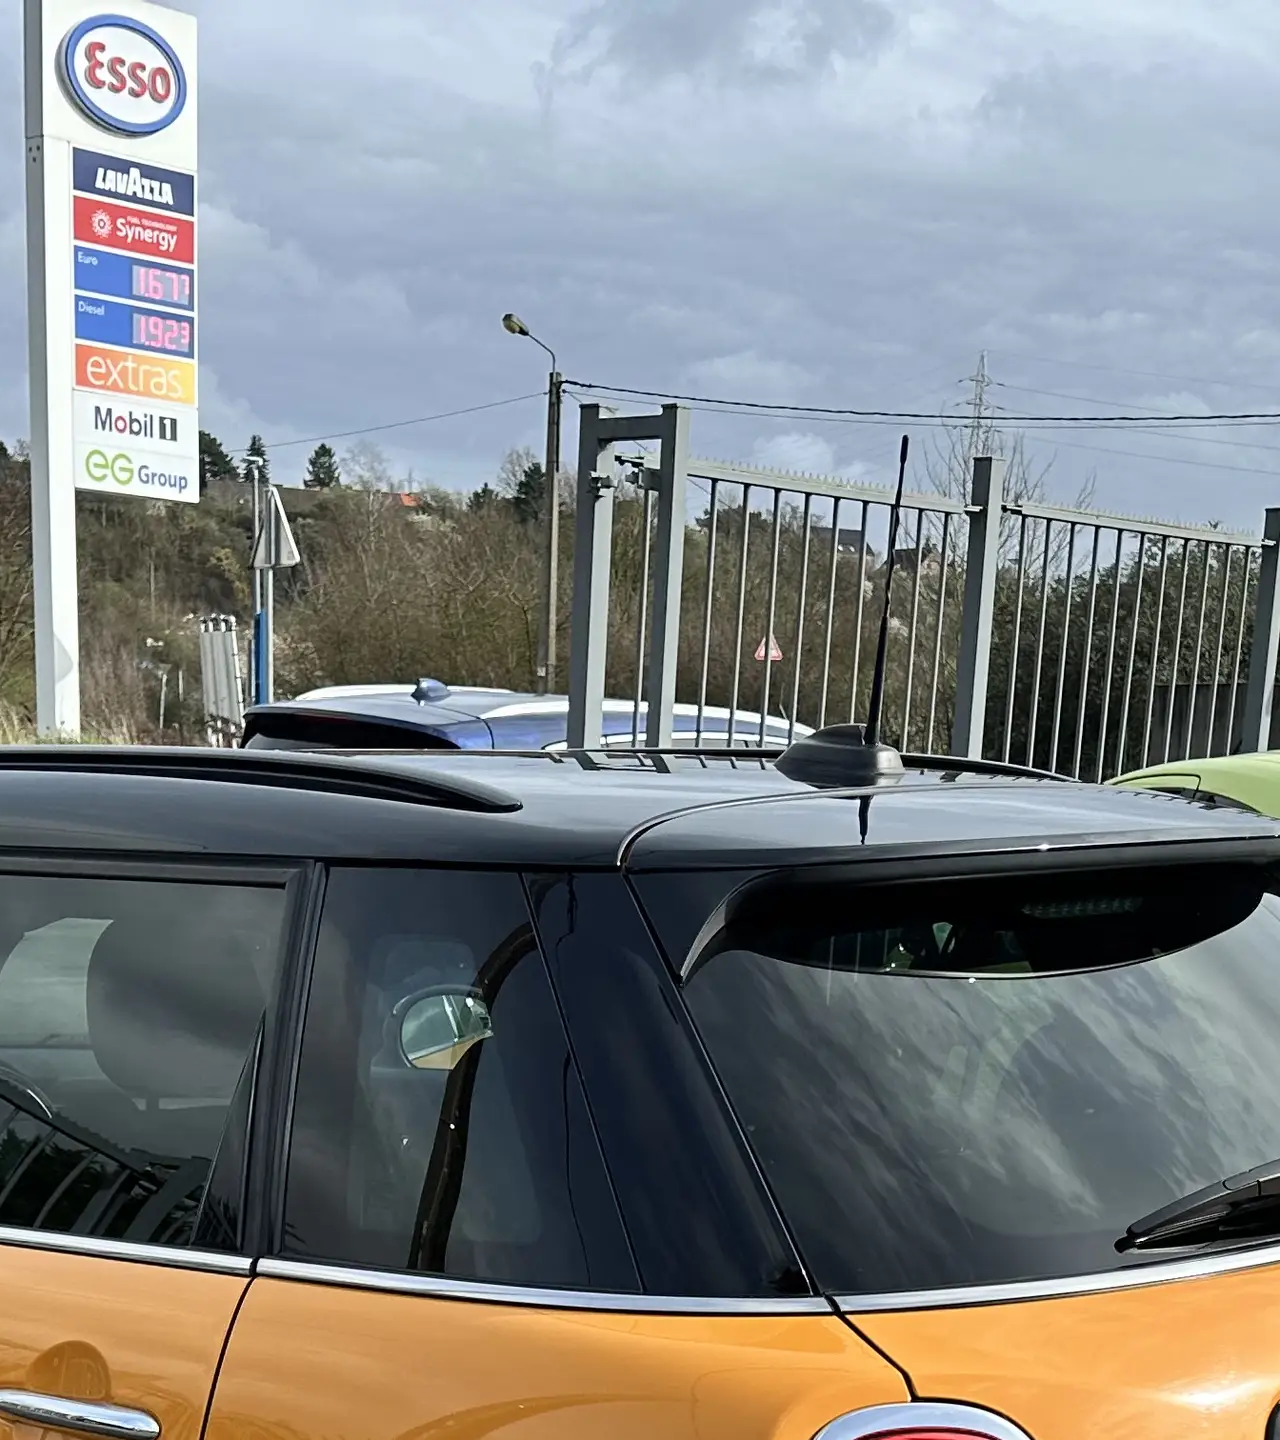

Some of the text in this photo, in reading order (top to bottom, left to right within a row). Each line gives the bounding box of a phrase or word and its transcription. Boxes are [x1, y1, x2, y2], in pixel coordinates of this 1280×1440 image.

[94, 166, 174, 206] LAVAZZA
[116, 217, 178, 253] Synergy
[77, 251, 99, 266] Euro
[78, 301, 105, 315] Diesel
[86, 355, 185, 399] extras
[94, 405, 154, 438] Mobil
[137, 465, 189, 493] Group
